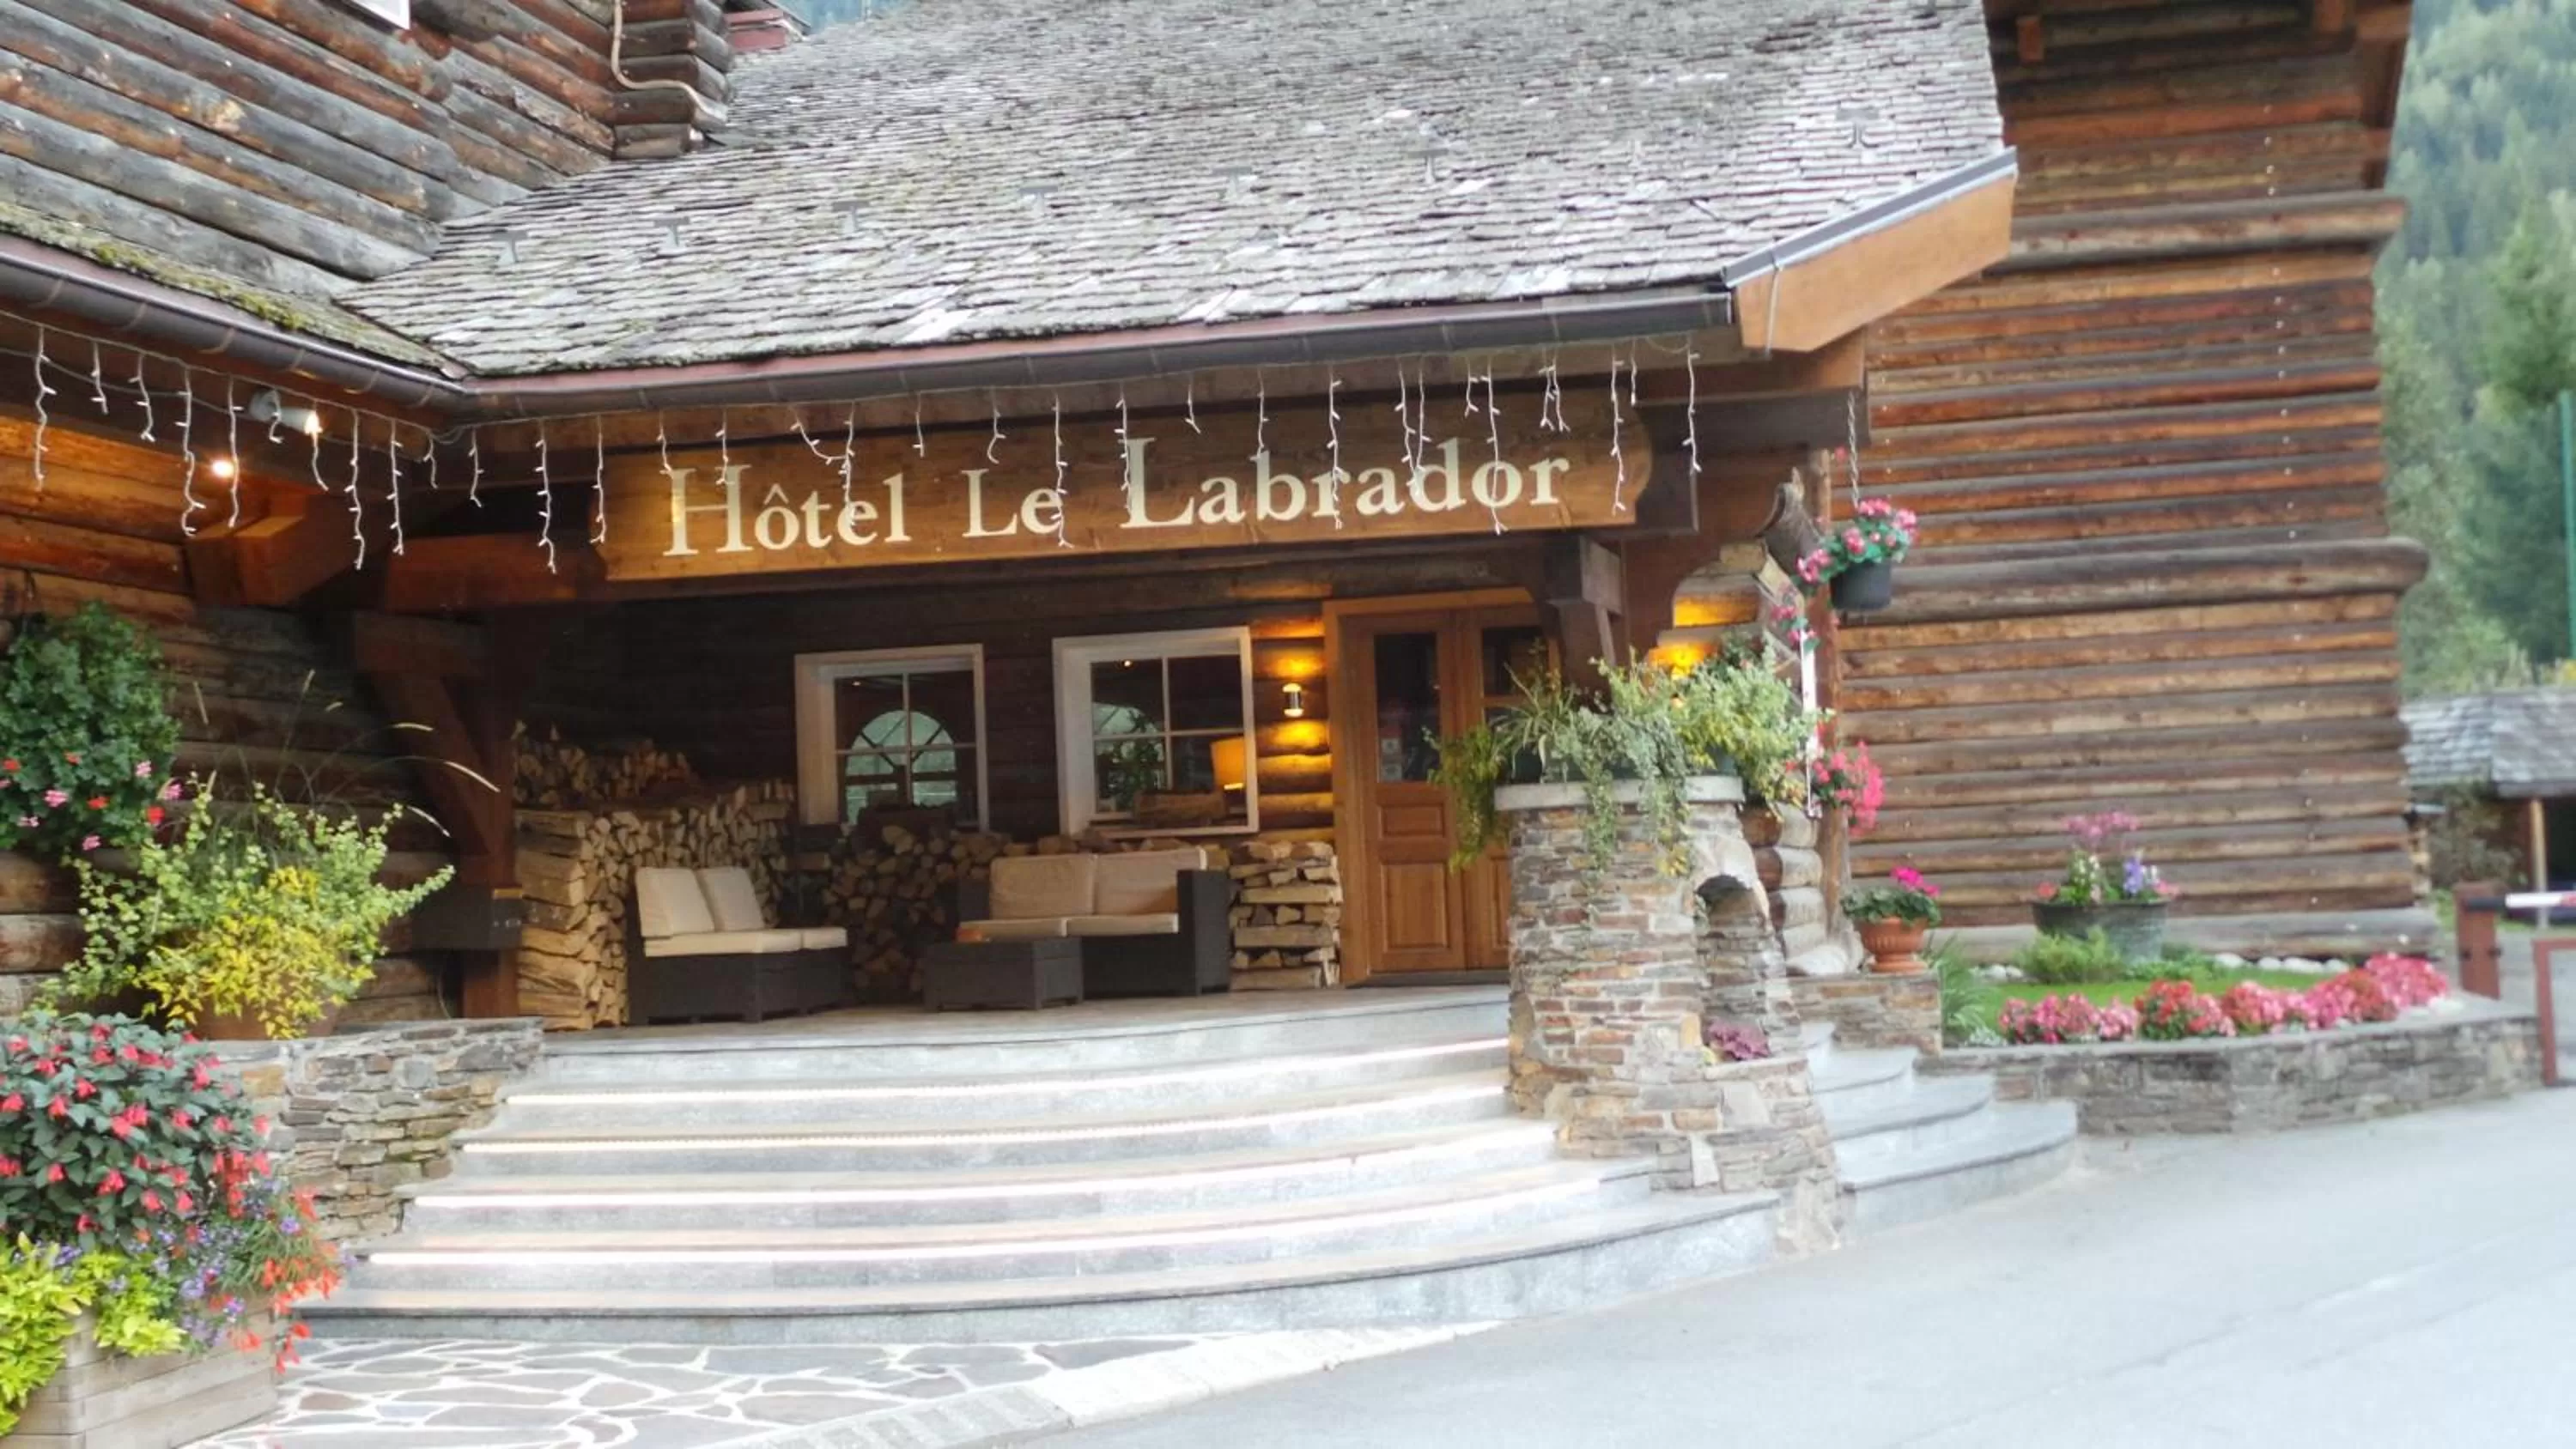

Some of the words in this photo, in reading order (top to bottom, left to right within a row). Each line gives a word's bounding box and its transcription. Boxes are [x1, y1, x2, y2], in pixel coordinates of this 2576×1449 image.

[663, 464, 911, 556] Hôtel
[962, 468, 1062, 539] Le
[1120, 436, 1570, 529] Labrador
